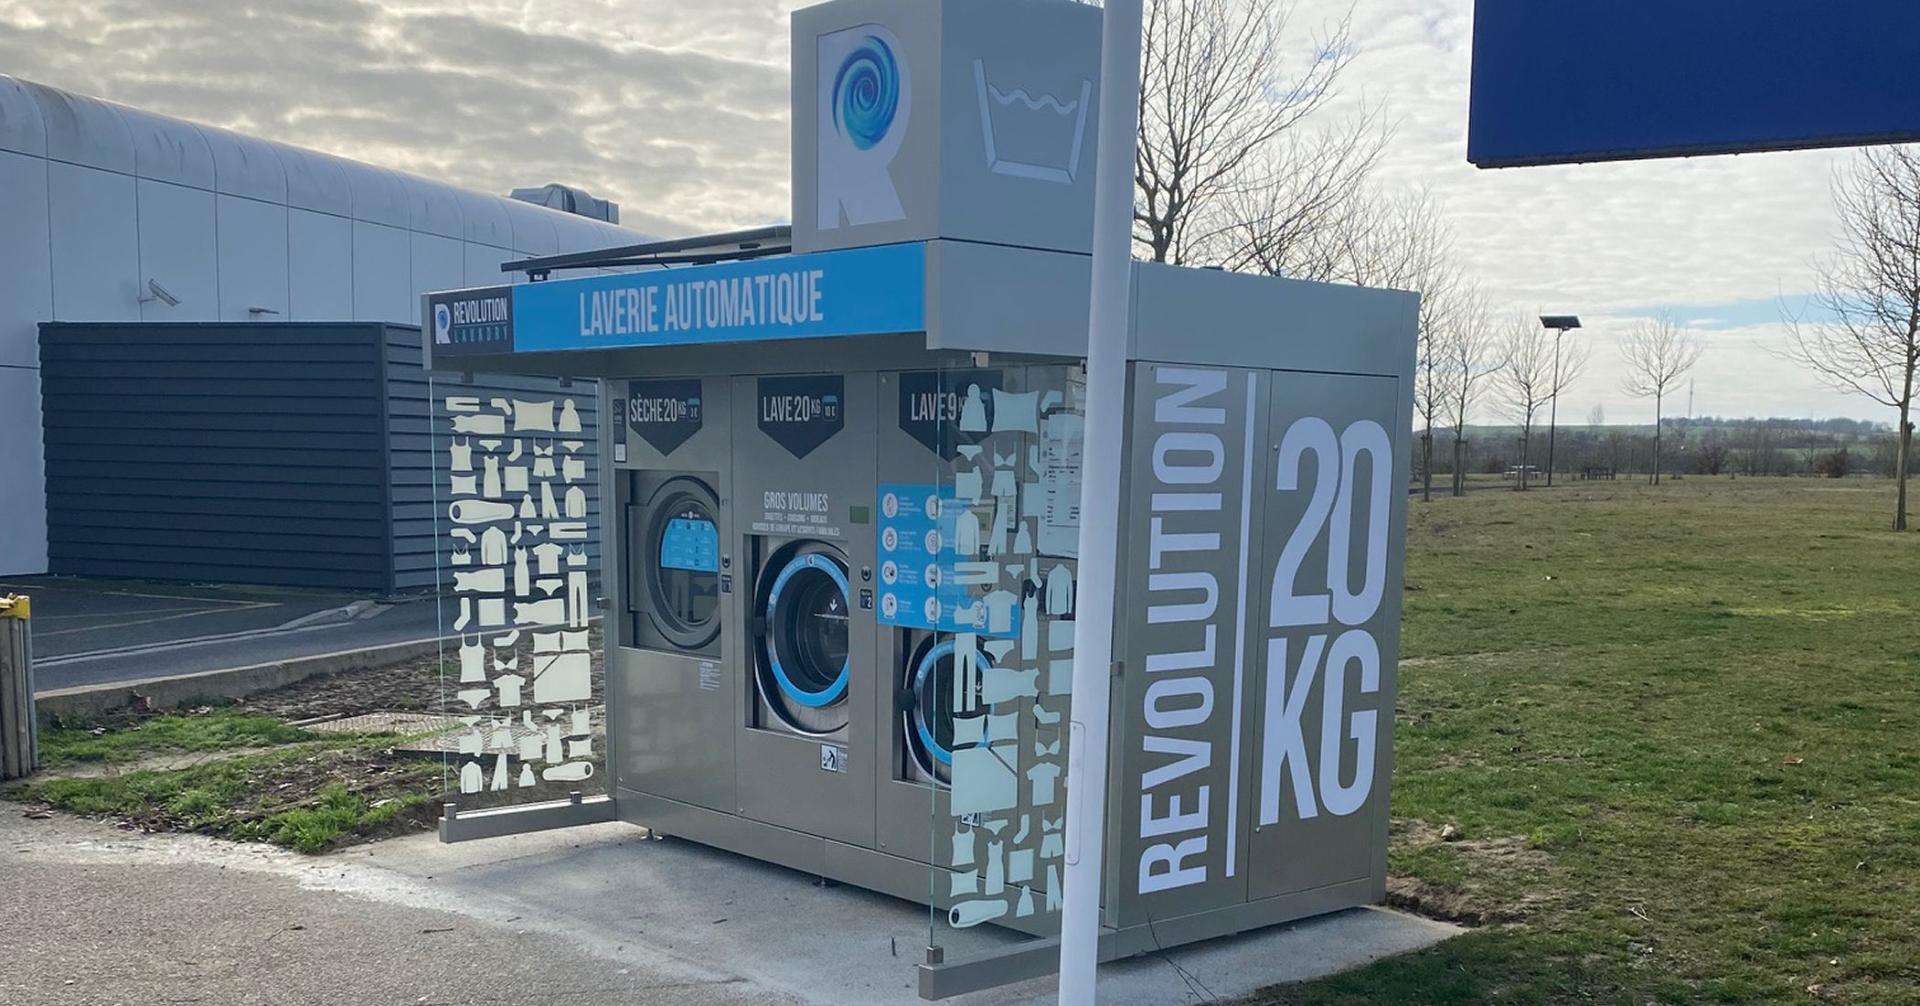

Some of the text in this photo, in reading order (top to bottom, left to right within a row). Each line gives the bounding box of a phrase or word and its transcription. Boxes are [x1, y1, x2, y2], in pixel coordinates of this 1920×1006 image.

[453, 297, 508, 324] REVOLUTION
[580, 270, 824, 336] LAVERIE AUTOMATIQUE
[763, 396, 793, 422] LAVE
[911, 392, 946, 421] LAVE
[763, 491, 829, 513] GROS VOLUMES
[1269, 416, 1393, 629] 20
[1138, 366, 1228, 895] REVOLUTION
[1259, 628, 1382, 819] KG
